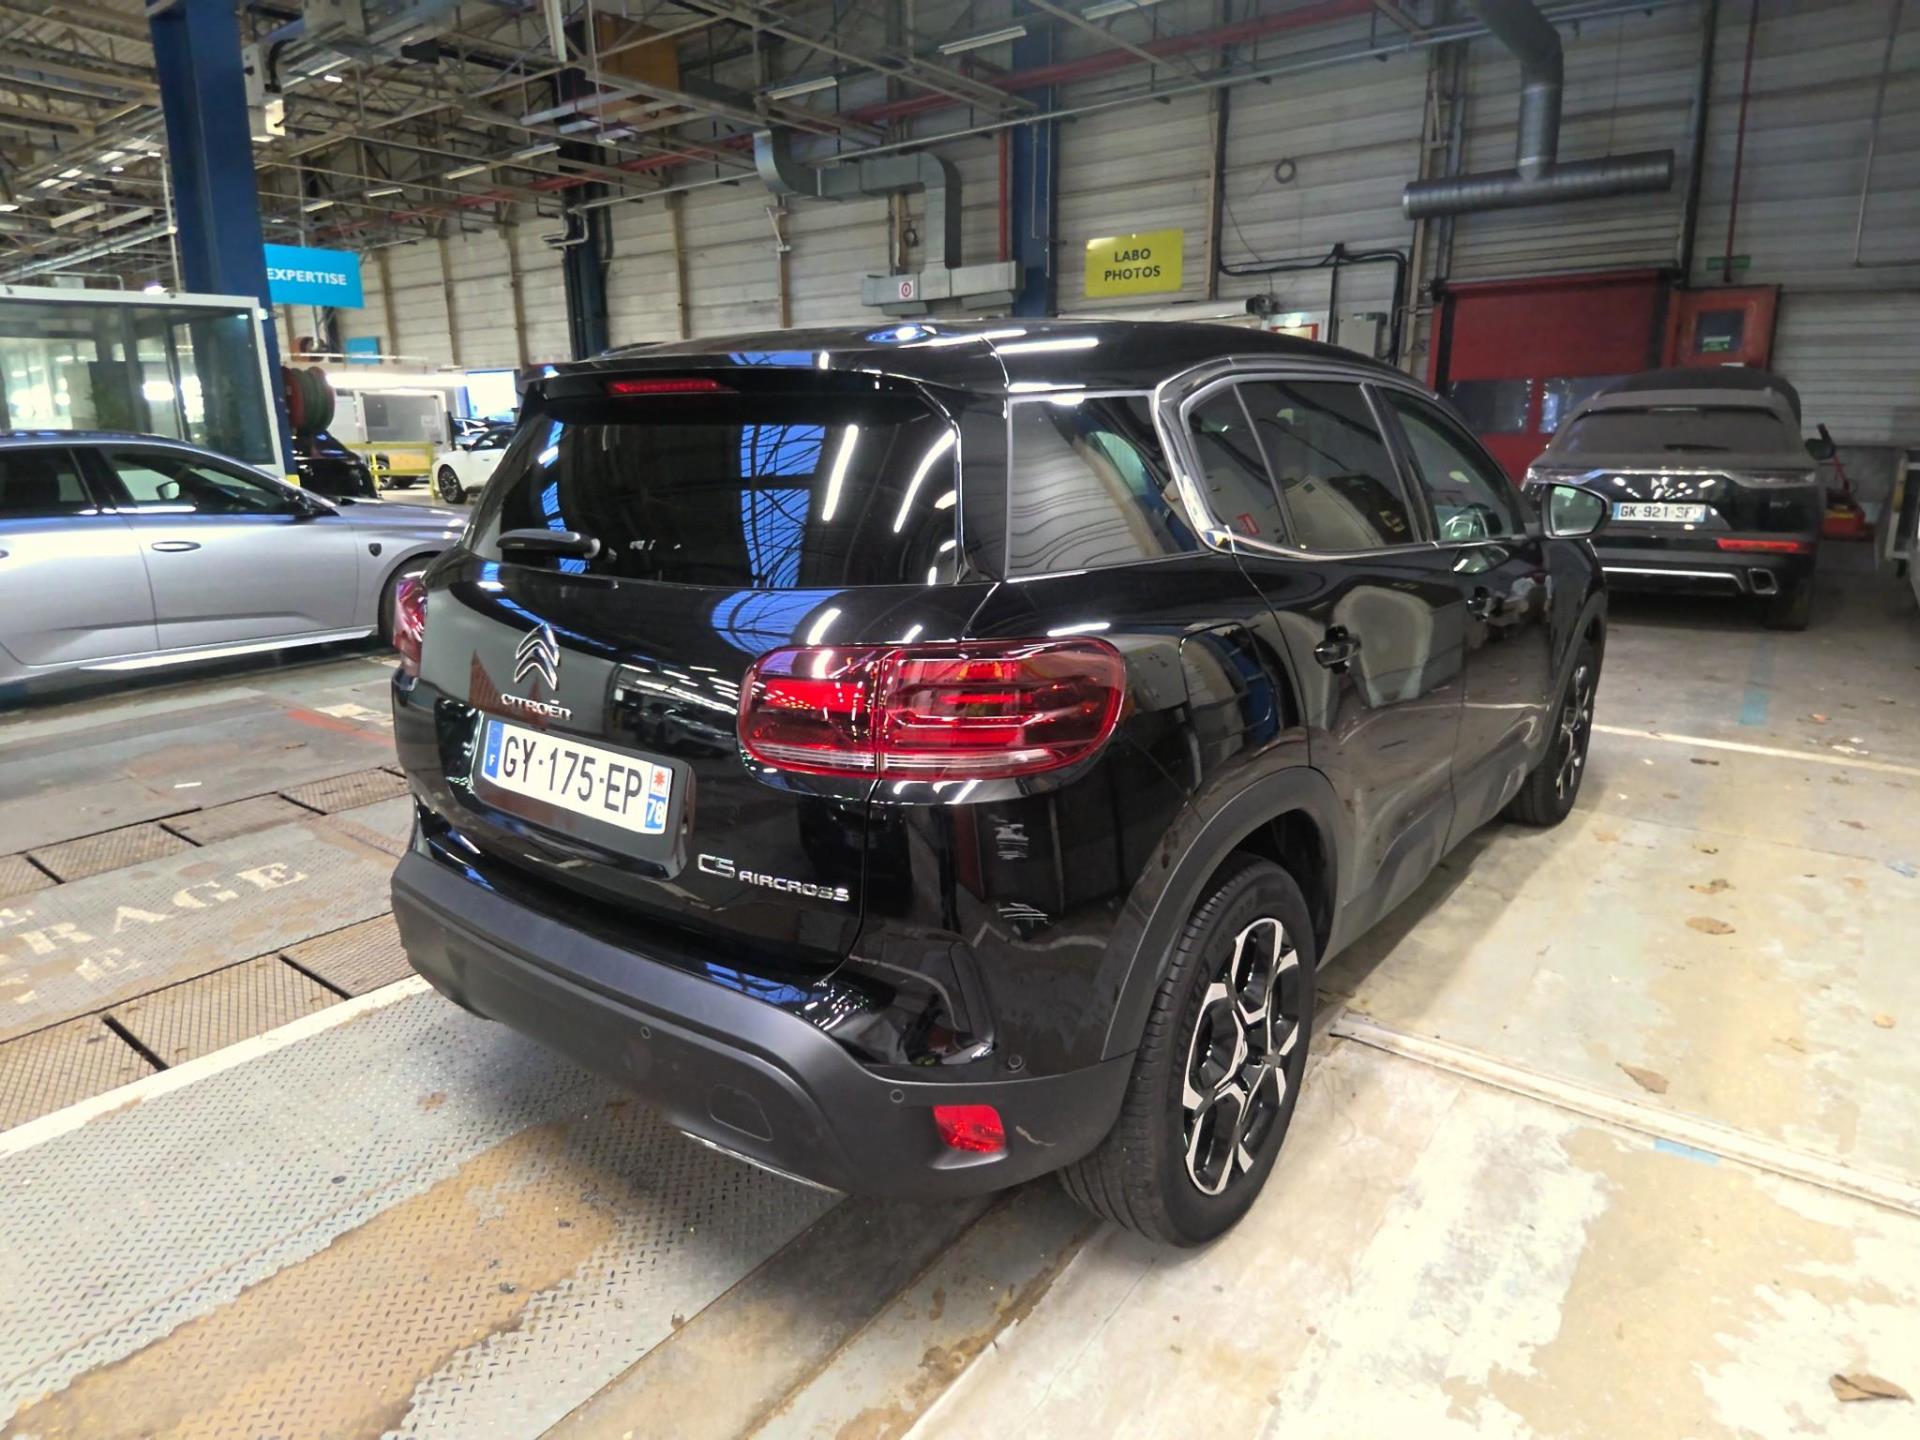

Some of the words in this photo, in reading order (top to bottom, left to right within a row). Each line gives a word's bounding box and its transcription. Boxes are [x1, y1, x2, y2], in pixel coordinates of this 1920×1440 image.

[1114, 248, 1151, 263] LABO
[266, 267, 348, 286] EXPERTISE
[1104, 265, 1161, 282] PHOTOS
[647, 797, 666, 826] 78
[698, 853, 736, 879] C5
[739, 870, 850, 902] AIRCROSS
